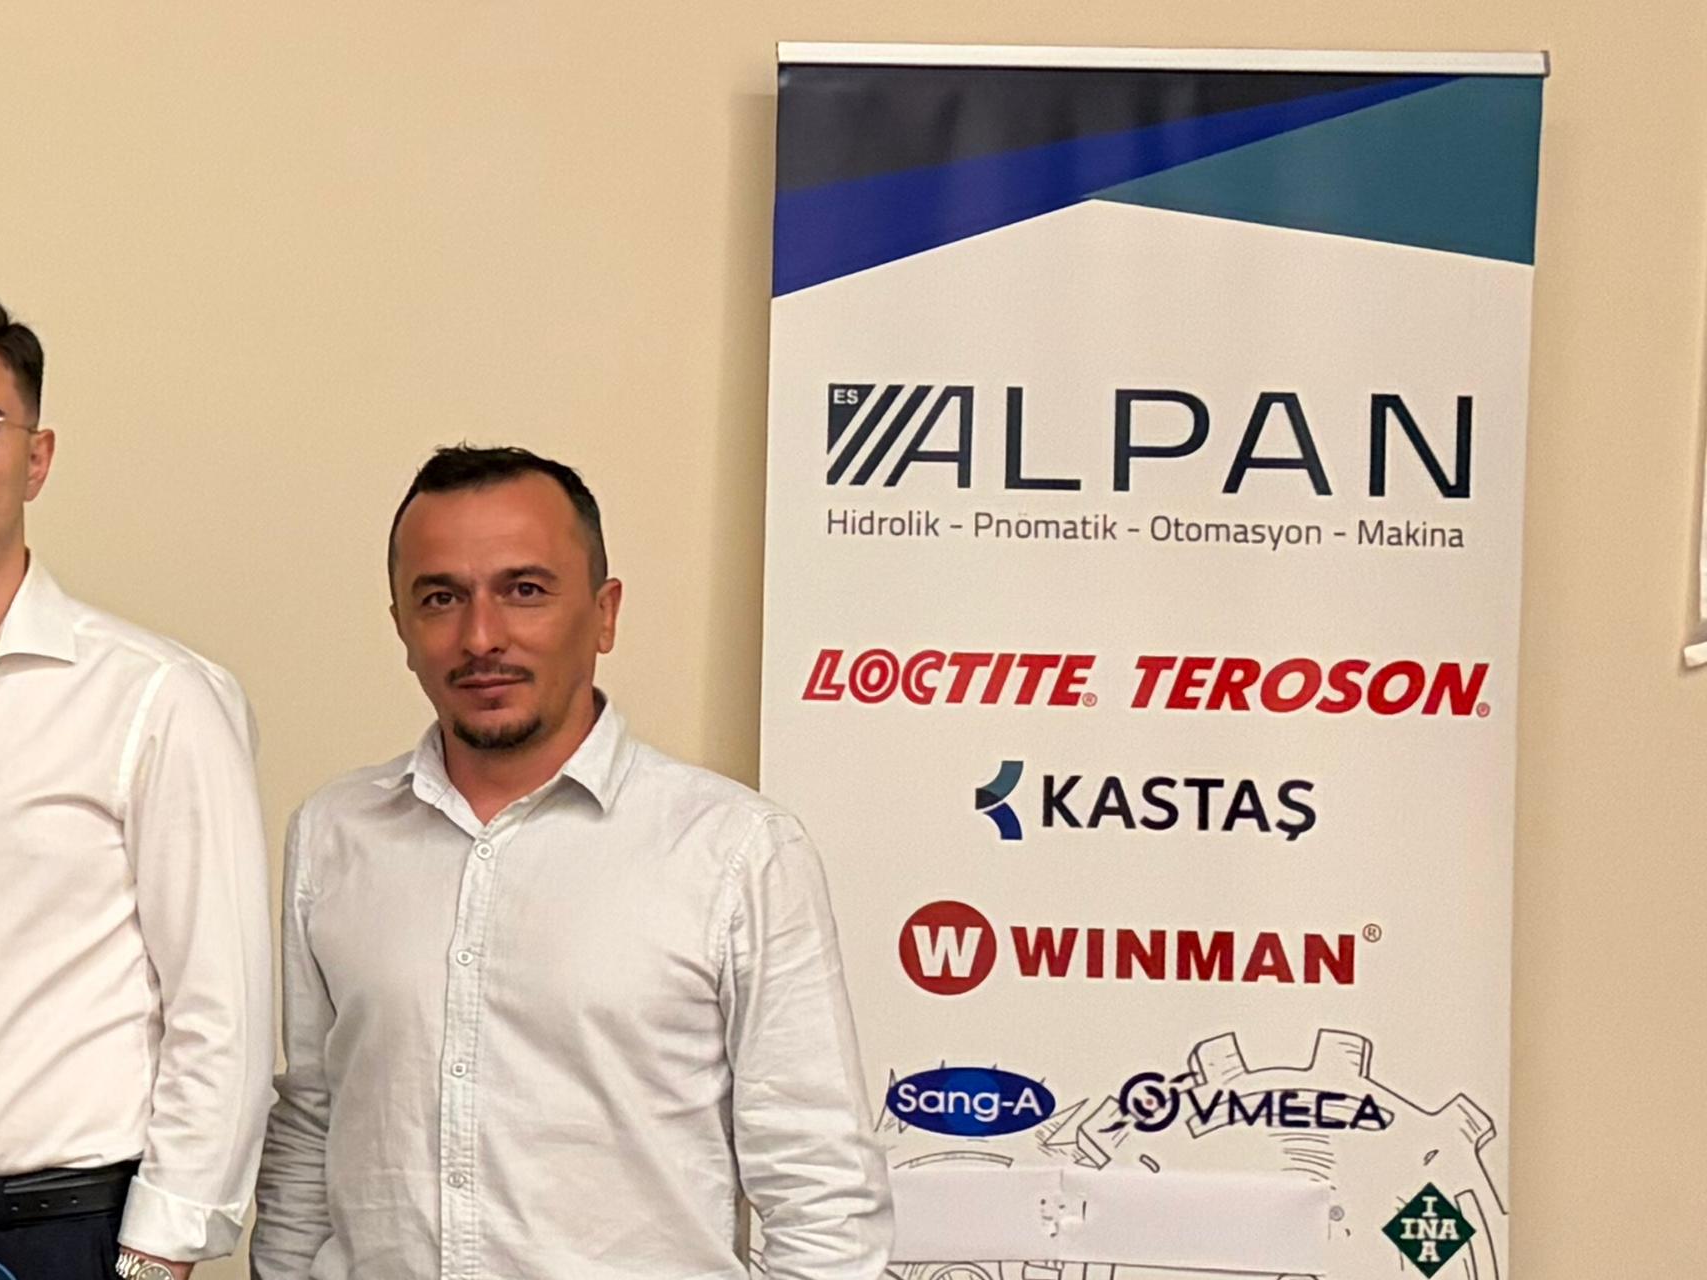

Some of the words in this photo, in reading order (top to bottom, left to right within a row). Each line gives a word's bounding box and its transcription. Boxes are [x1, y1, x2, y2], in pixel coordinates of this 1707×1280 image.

[833, 388, 860, 405] ES
[882, 384, 1473, 499] ALPAN
[827, 508, 940, 537] Hidrolik
[974, 511, 1118, 540] Pnömatik
[1150, 515, 1322, 552] Otomasyon
[1357, 519, 1465, 548] Makina
[1042, 774, 1316, 842] KASTAŞ
[895, 1083, 1043, 1117] Sang-A
[1188, 1089, 1389, 1130] VMECA
[1399, 1217, 1460, 1241] INA
